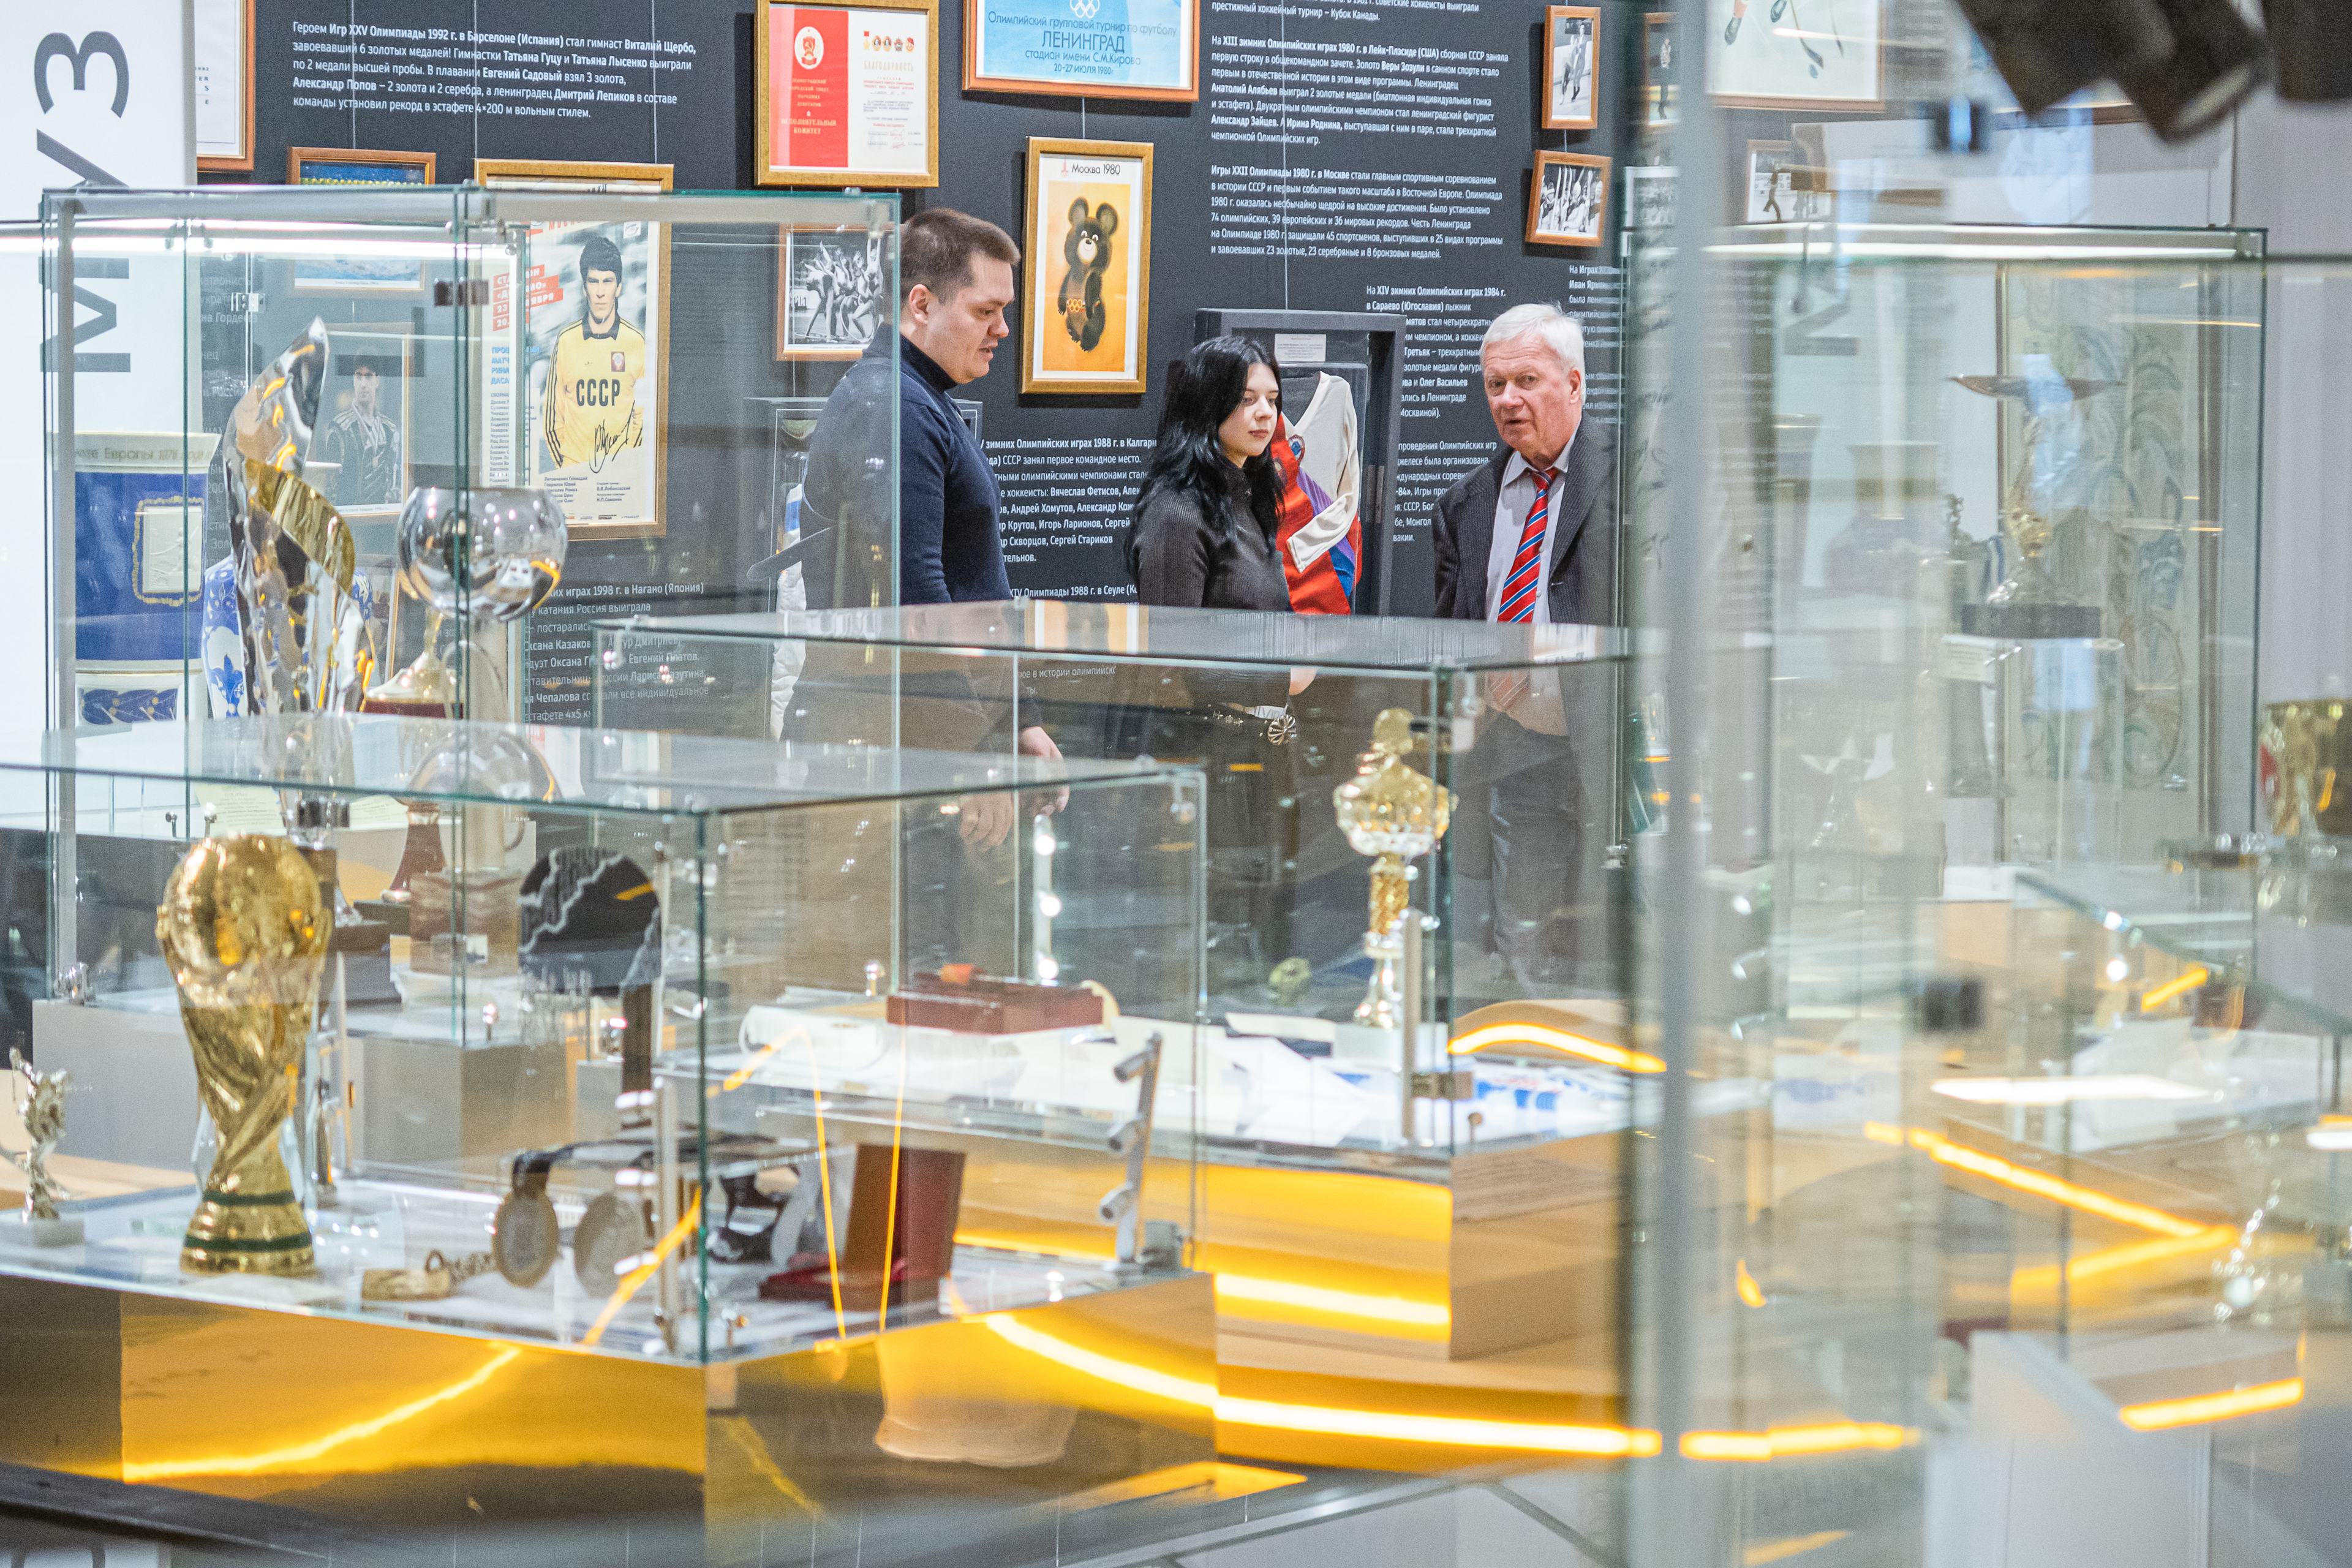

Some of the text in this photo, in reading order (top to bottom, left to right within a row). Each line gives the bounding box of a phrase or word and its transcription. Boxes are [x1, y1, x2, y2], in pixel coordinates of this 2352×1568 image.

[1212, 2, 1380, 21] престижный хоккейный турнир Кубок Канады.
[988, 11, 1047, 26] Олимпийский
[1050, 18, 1094, 30] групповой
[1096, 22, 1126, 33] турнир
[293, 21, 696, 55] Героем Игр XXV Олимпиады 1992 г. в Барселоне (Испания) стал гимнаст Виталий Щербо,
[1042, 31, 1125, 53] ЛЕНИНГРАД
[293, 42, 357, 53] завоевавший
[360, 43, 366, 54] 6
[368, 45, 407, 55] золотых
[409, 47, 451, 58] медалей!
[453, 48, 501, 60] Гимнастки
[503, 50, 539, 62] Татьяна
[541, 52, 562, 66] Гуцу
[571, 53, 606, 66] Татьяна
[608, 56, 647, 67] Лысенко
[649, 60, 692, 71] выиграли
[1212, 35, 1221, 45] На
[1223, 36, 1238, 46] XIII
[1238, 39, 1266, 47] зимних
[1267, 39, 1316, 50] Олимпийских
[1317, 43, 1337, 53] играх
[1338, 43, 1355, 53] 1980
[1368, 45, 1417, 58] Лейк-Плэсиде
[1417, 47, 1439, 59] (США)
[1440, 49, 1467, 60] сборная
[1468, 50, 1485, 60] СССР
[1486, 53, 1509, 62] заняла
[864, 60, 914, 72] БЛАГОДАРНОСТЬ
[1025, 50, 1140, 67] стадион имени С.М.Кирова
[1054, 62, 1073, 73] 20-27
[293, 59, 626, 85] по 2 медали высшей пробы. В плавании Евгений Садовый взял 3 золота,
[293, 77, 677, 104] Александр Попов 2 золота и 2 серебра, а ленинградец Дмитрий Лепиков в составе
[293, 97, 336, 108] команды
[338, 99, 387, 110] установил
[390, 101, 423, 112] рекорд
[424, 102, 430, 111] в
[432, 102, 474, 114] эстафете
[514, 106, 555, 116] вольным
[557, 108, 590, 118] стилем.
[1071, 162, 1120, 175] Москва 1980
[1211, 165, 1231, 176] Игры
[1232, 165, 1248, 176] XXII
[1249, 166, 1292, 178] Олимпиады
[1293, 168, 1310, 178] 1980
[1317, 170, 1322, 179] в
[1323, 169, 1350, 179] Москве
[1402, 174, 1444, 183] спортивным
[1445, 175, 1496, 184] соревнованием
[1366, 285, 1376, 295] На
[1377, 285, 1389, 295] XIV
[1417, 286, 1463, 296] Олимпийских
[1464, 288, 1483, 298] играх
[1484, 287, 1499, 296] 1984
[1372, 301, 1400, 312] Сараево
[1401, 301, 1444, 312] (Югославия)
[576, 379, 620, 407] СССР
[1016, 438, 1069, 448] Олимпийских
[1070, 440, 1092, 450] играх
[1093, 437, 1111, 448] 1988
[1398, 440, 1497, 451] проведения Олимпийских игр
[1002, 454, 1021, 465] СССР
[1047, 456, 1074, 466] первое
[1076, 456, 1117, 464] командное
[565, 588, 591, 598] играх
[593, 585, 614, 595] 1998
[624, 586, 630, 595] в
[631, 584, 663, 594] Нагано
